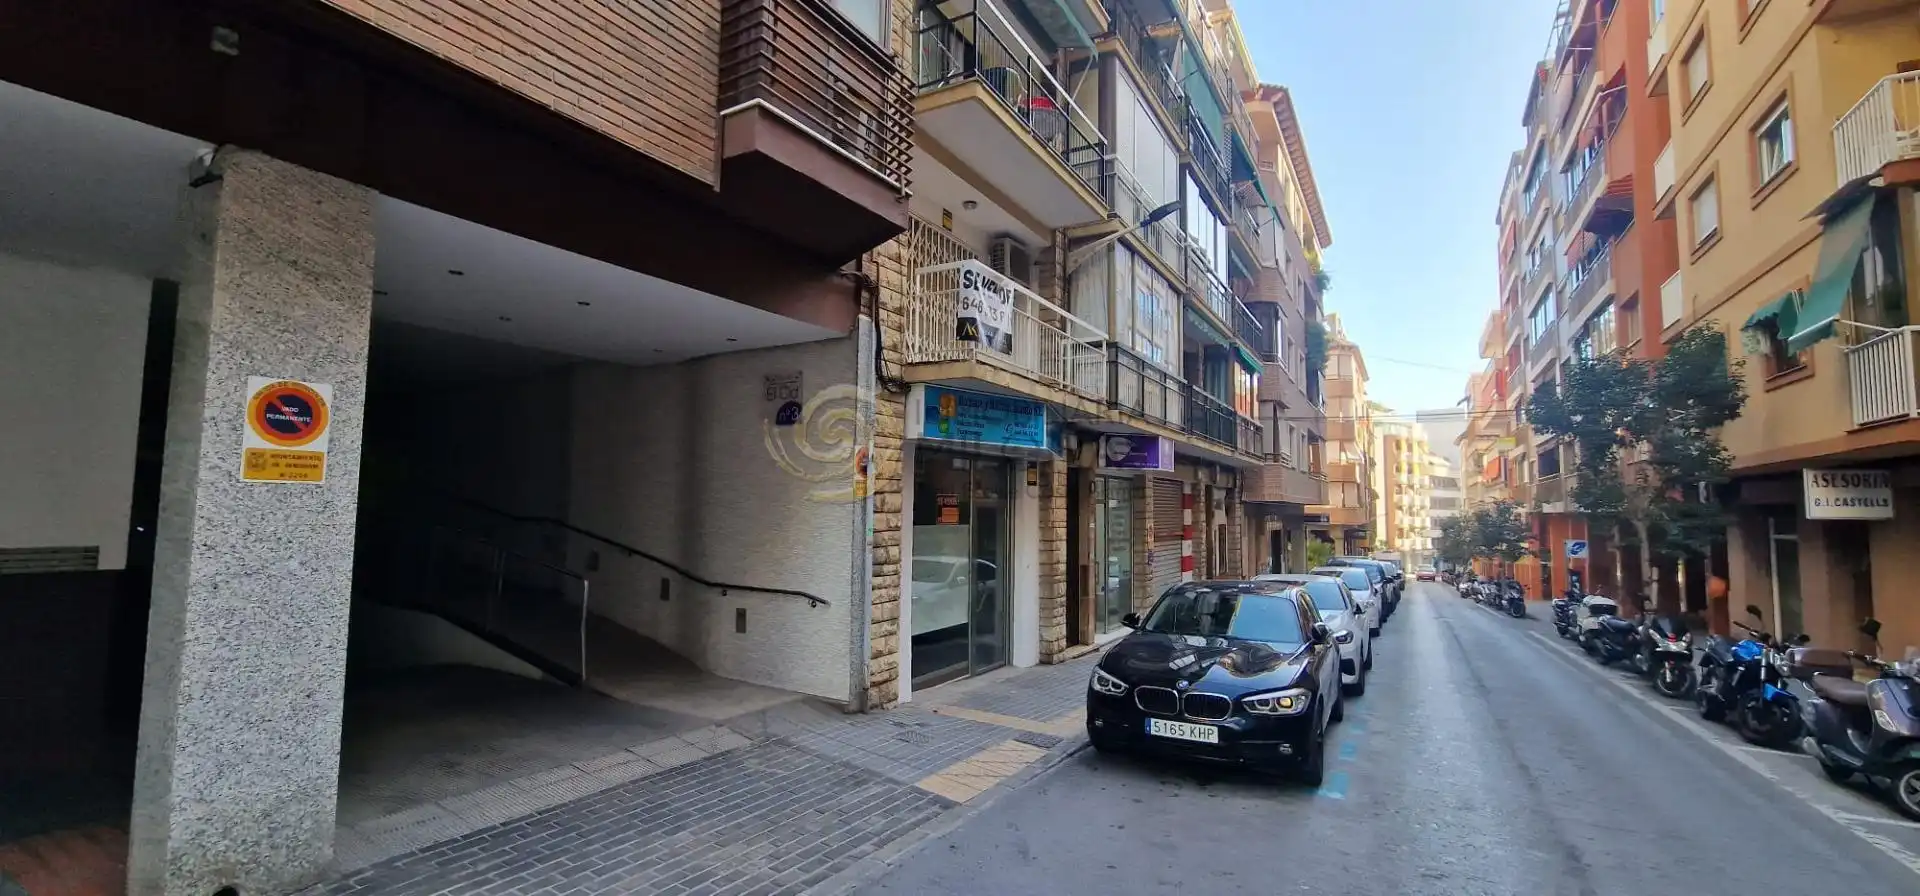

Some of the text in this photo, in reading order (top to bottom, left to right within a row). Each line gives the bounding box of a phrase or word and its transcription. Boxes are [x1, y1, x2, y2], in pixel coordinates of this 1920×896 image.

[266, 413, 312, 423] PERMANENTE
[1811, 473, 1890, 488] ASESORIA
[1153, 720, 1215, 740] 5165 KHP
